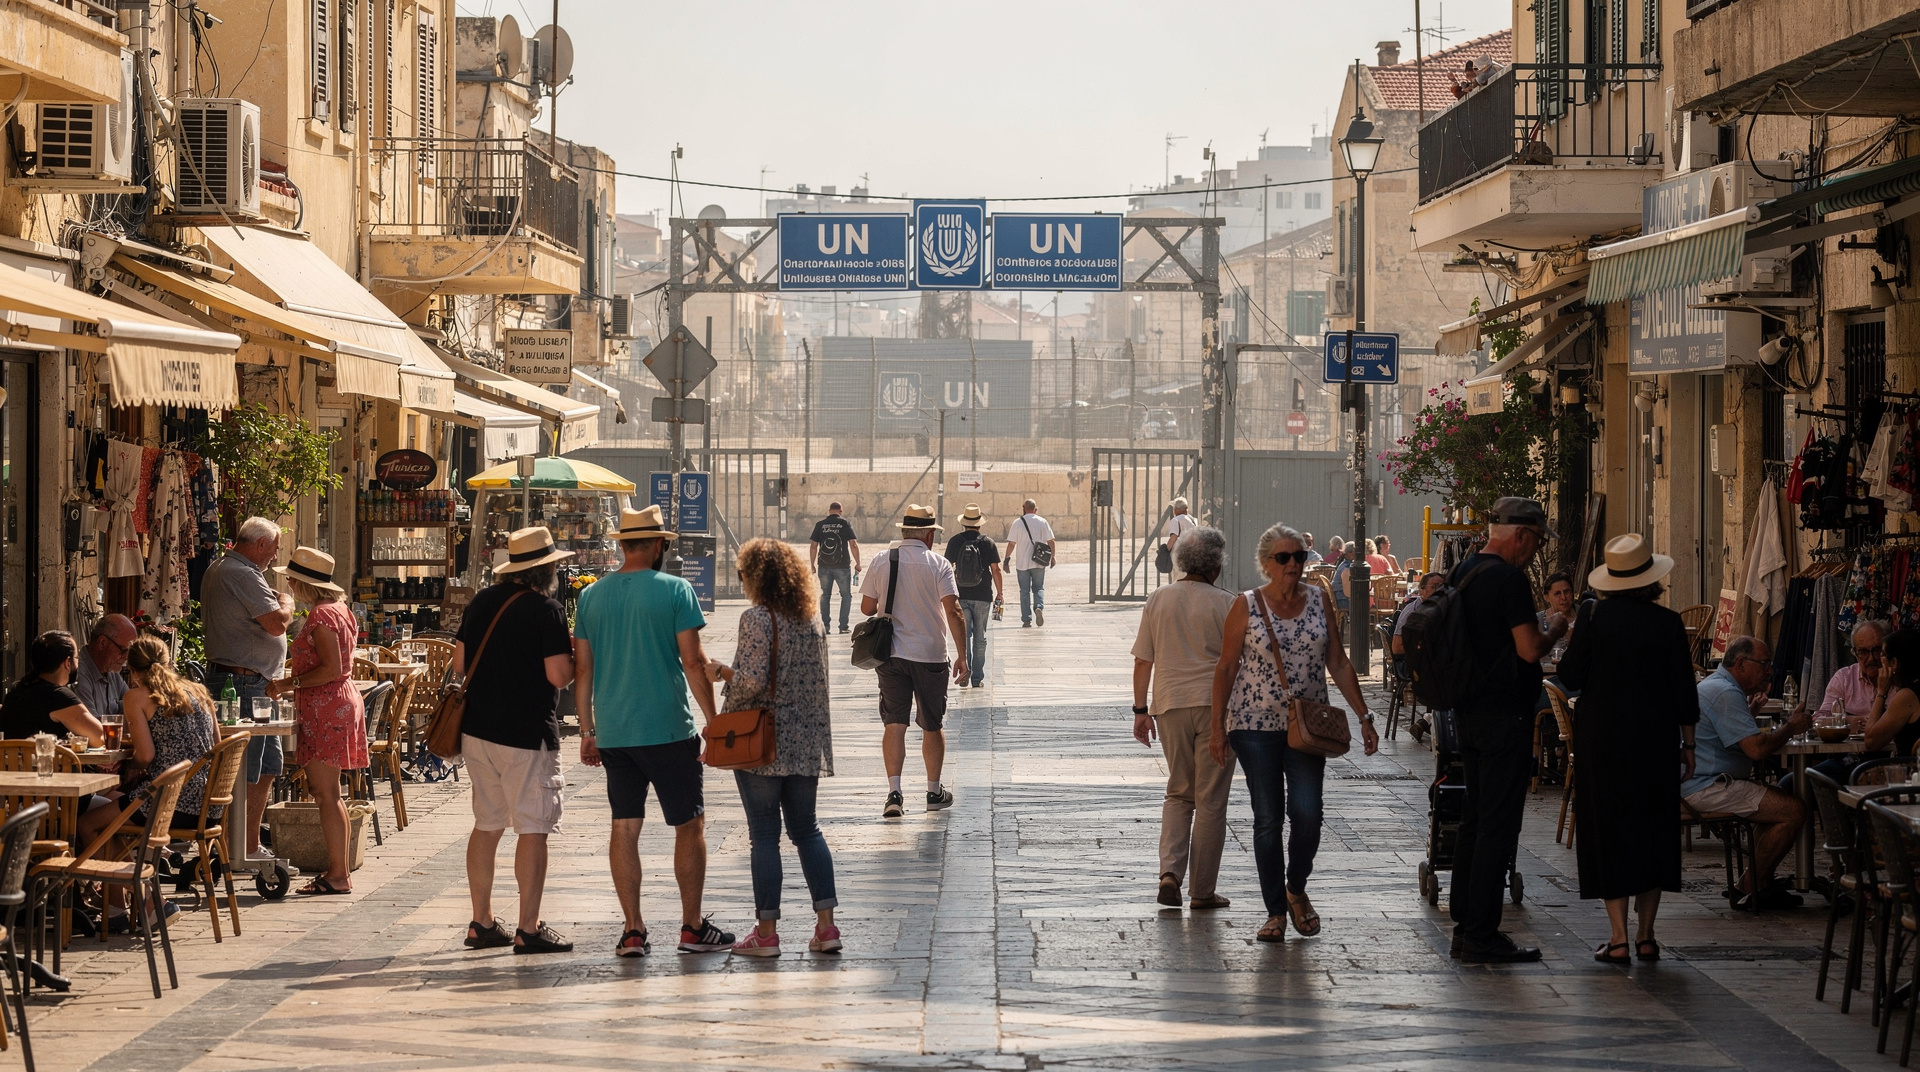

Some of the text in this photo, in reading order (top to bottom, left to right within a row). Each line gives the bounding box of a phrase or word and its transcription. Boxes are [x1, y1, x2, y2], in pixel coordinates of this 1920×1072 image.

[818, 223, 869, 255] UN
[1030, 223, 1082, 254] UN
[944, 381, 989, 409] UN
